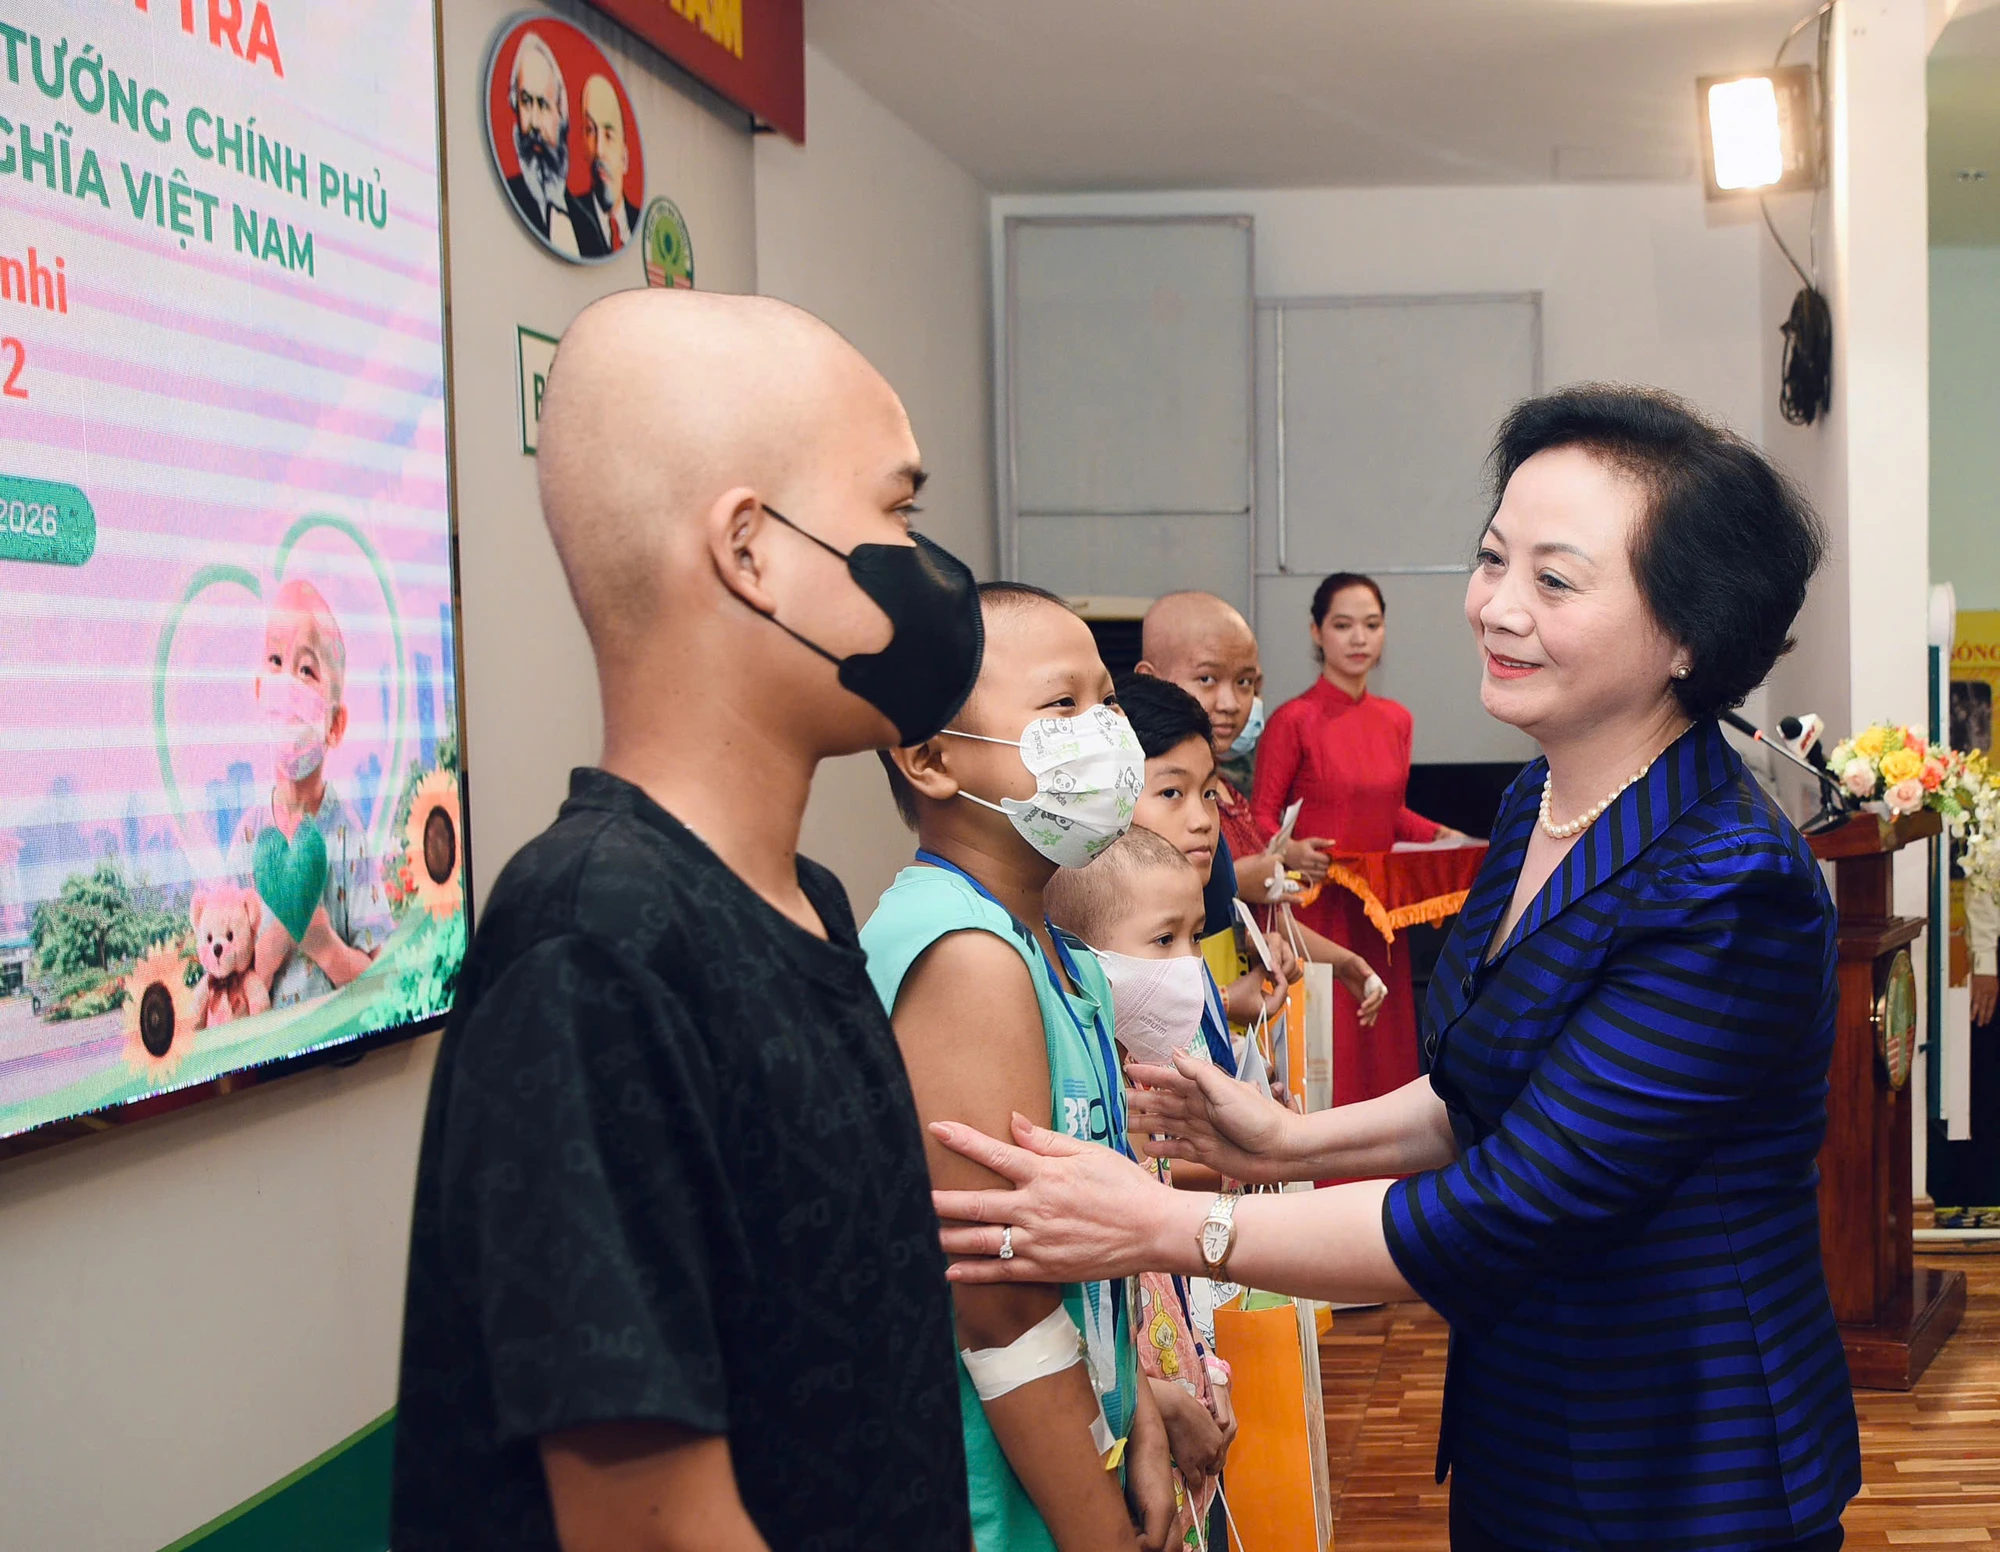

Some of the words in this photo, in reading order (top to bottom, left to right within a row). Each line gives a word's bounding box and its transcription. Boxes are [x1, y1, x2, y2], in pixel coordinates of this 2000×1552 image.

[0, 21, 173, 144] TƯỚNG
[186, 106, 308, 200] CHÍNH
[319, 161, 388, 230] PHỦ
[120, 167, 220, 250] VIỆT
[232, 203, 315, 278] NAM
